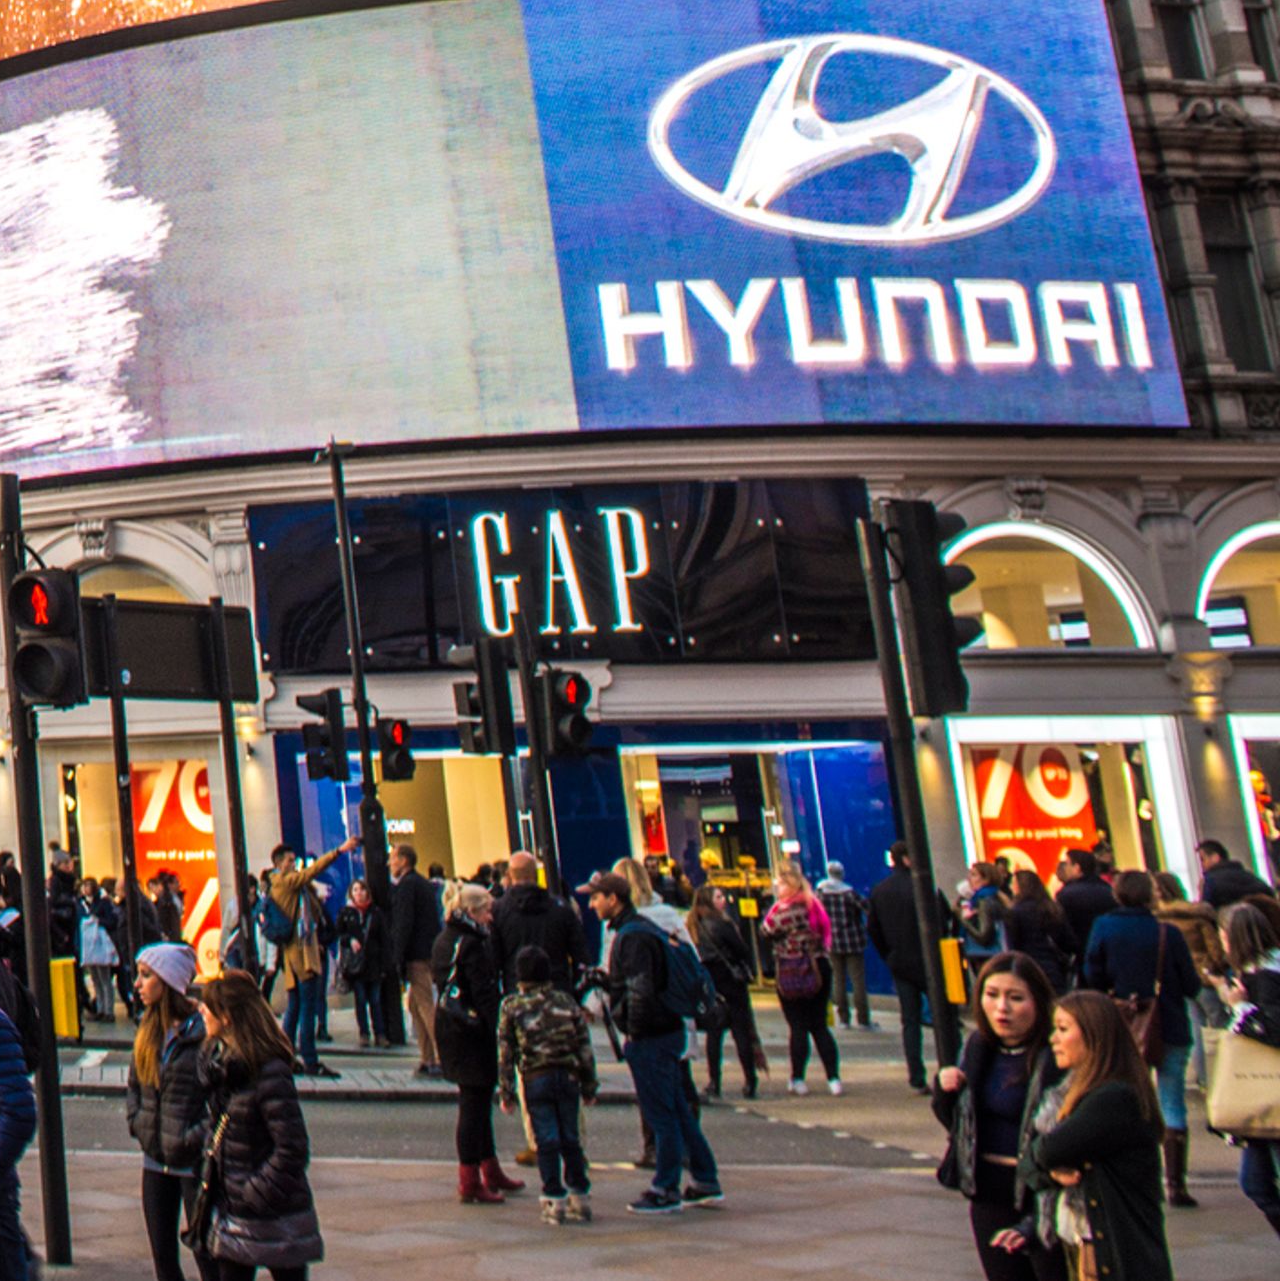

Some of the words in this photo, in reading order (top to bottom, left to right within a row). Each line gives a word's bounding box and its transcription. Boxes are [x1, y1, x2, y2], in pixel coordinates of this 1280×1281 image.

[596, 275, 1154, 373] HYUNDAI
[472, 506, 652, 637] GAP
[981, 743, 1090, 819] 70
[146, 850, 167, 860] more
[167, 849, 177, 860] of
[178, 850, 183, 860] a
[184, 849, 205, 862] good
[987, 829, 1014, 840] more
[1014, 828, 1025, 840] of
[1026, 829, 1033, 840] a
[1034, 828, 1059, 841] good
[1059, 827, 1084, 841] thing
